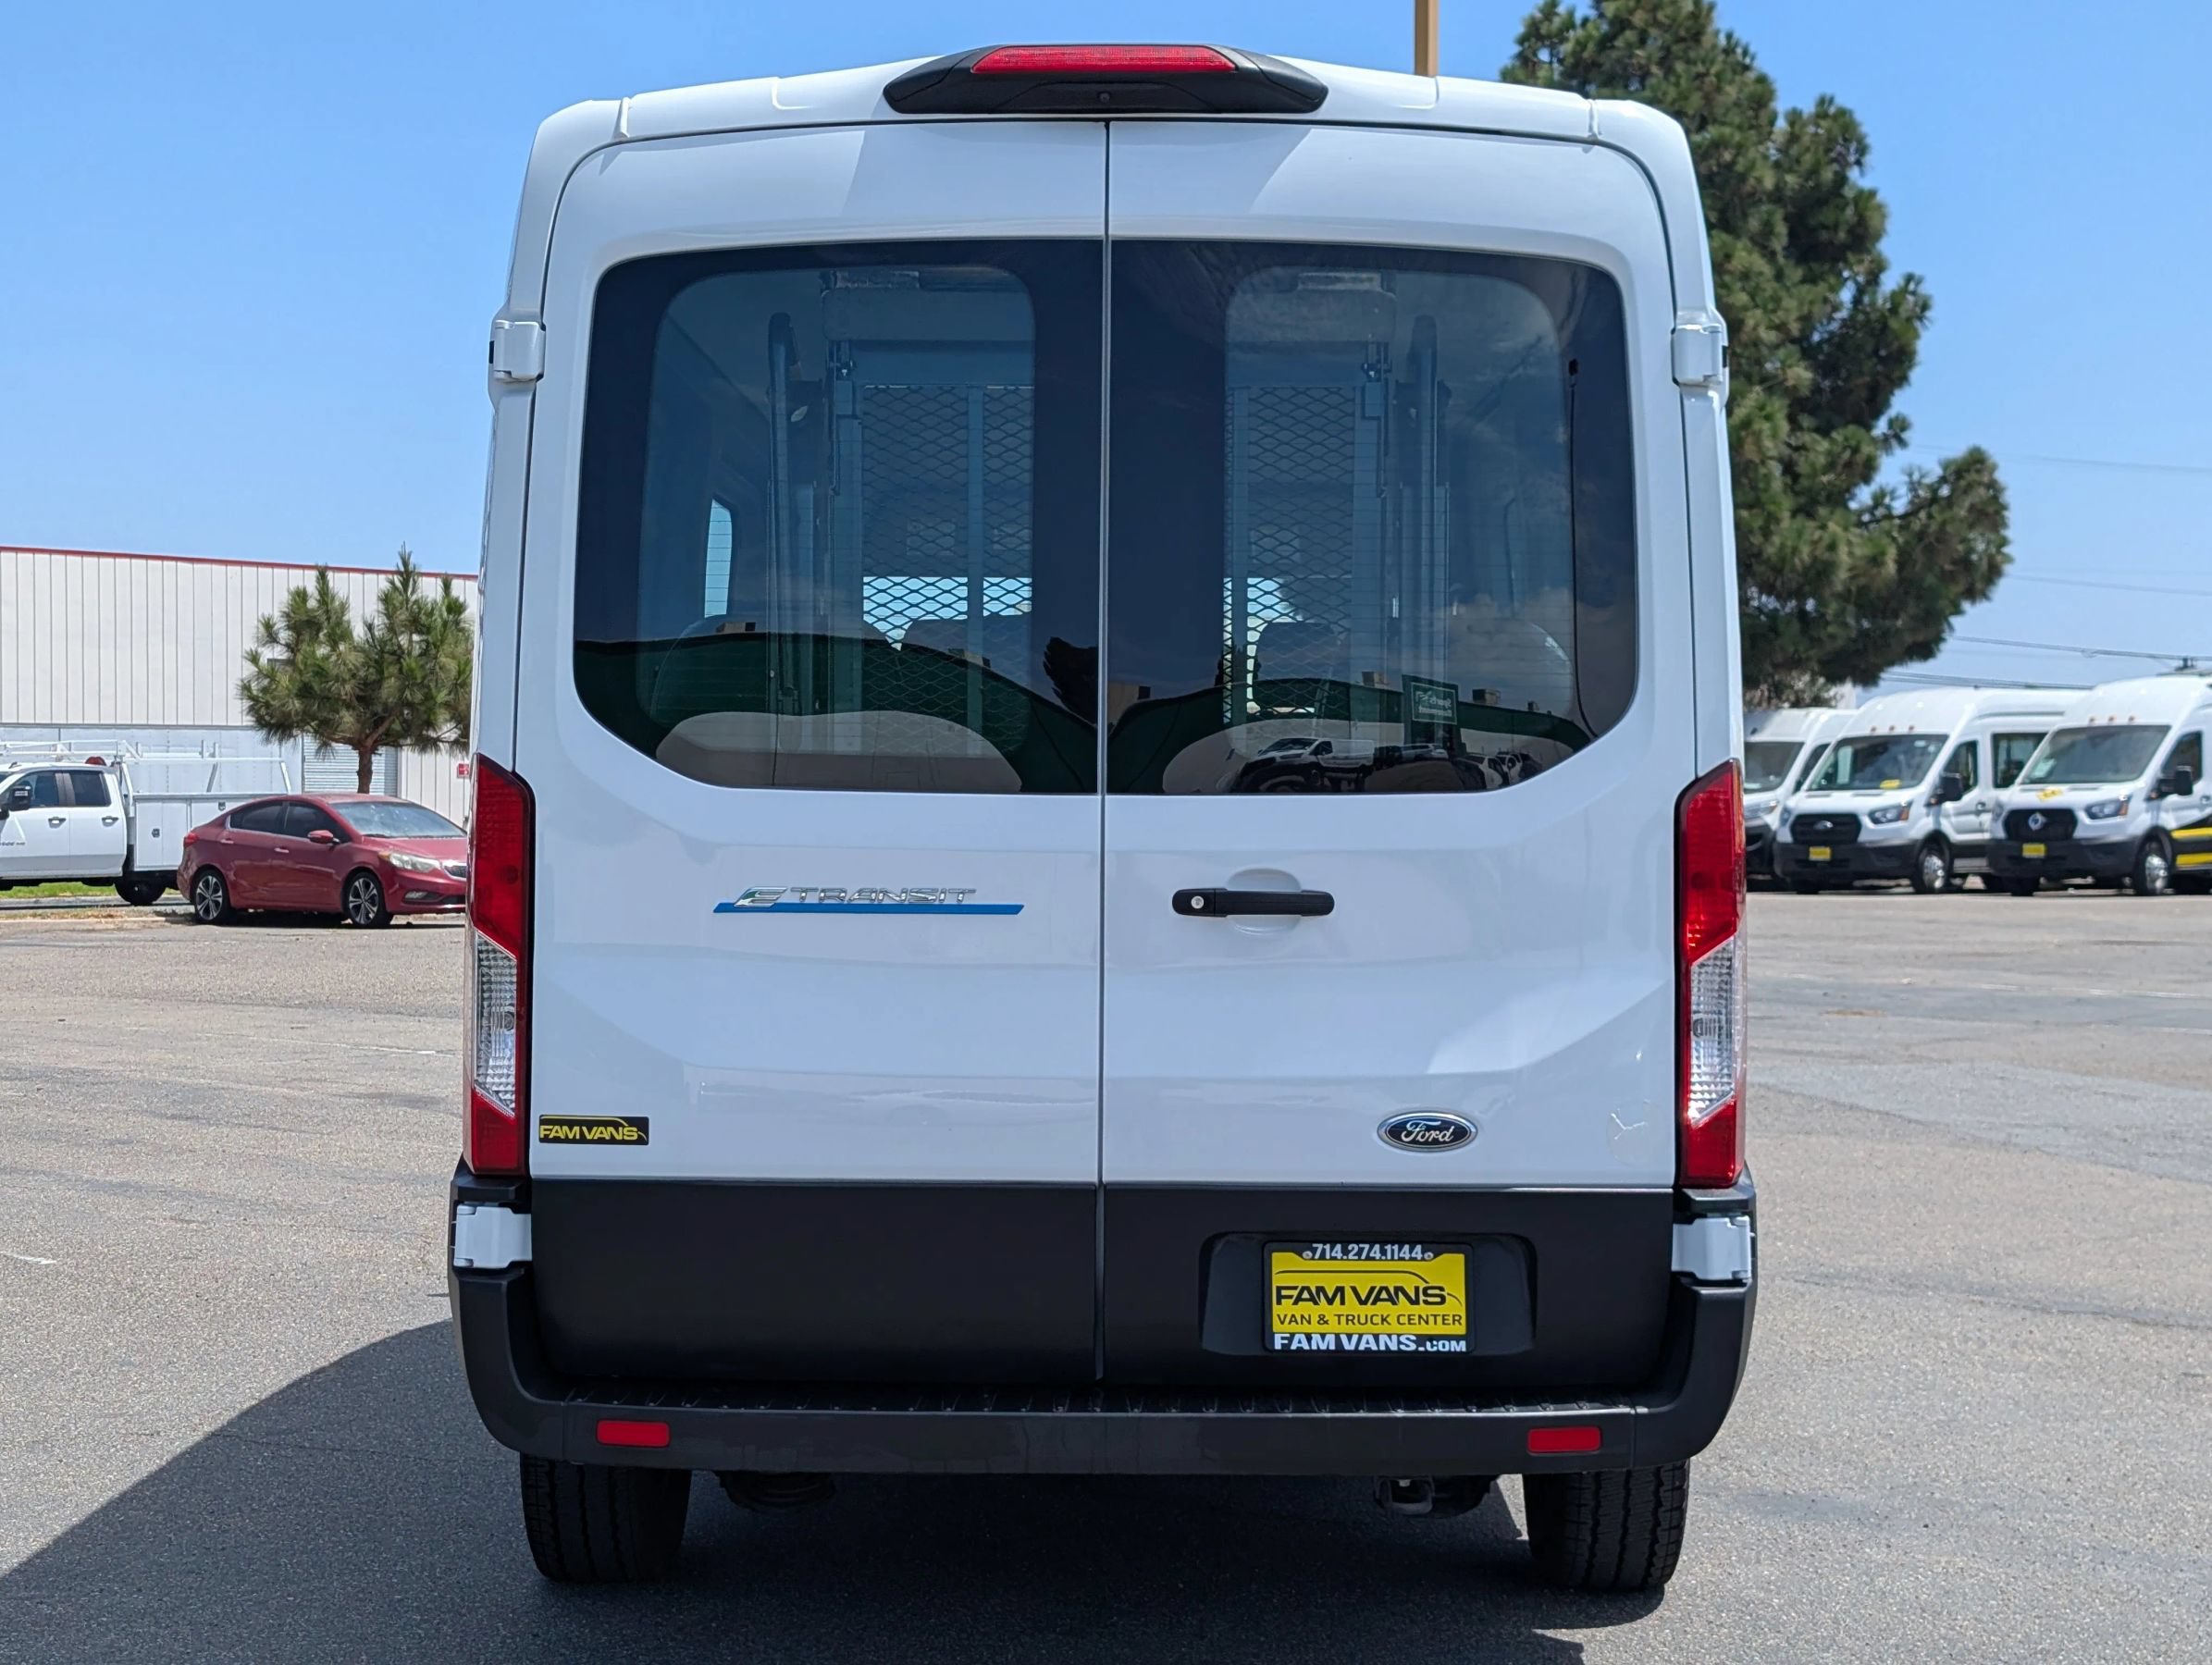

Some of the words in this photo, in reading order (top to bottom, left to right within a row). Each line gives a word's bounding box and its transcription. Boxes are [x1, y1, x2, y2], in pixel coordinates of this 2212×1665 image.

[790, 886, 977, 905] TRANSIT
[539, 1125, 579, 1140] FAM
[581, 1125, 638, 1141] VANS
[1401, 1119, 1455, 1142] Ford
[1312, 1243, 1423, 1261] 714.274.1144
[1275, 1285, 1345, 1306] FAM
[1349, 1285, 1447, 1306] VANS
[1277, 1314, 1312, 1326] VAN
[1316, 1314, 1329, 1326] &
[1333, 1313, 1391, 1326] TRUCK
[1396, 1313, 1463, 1326] CENTER
